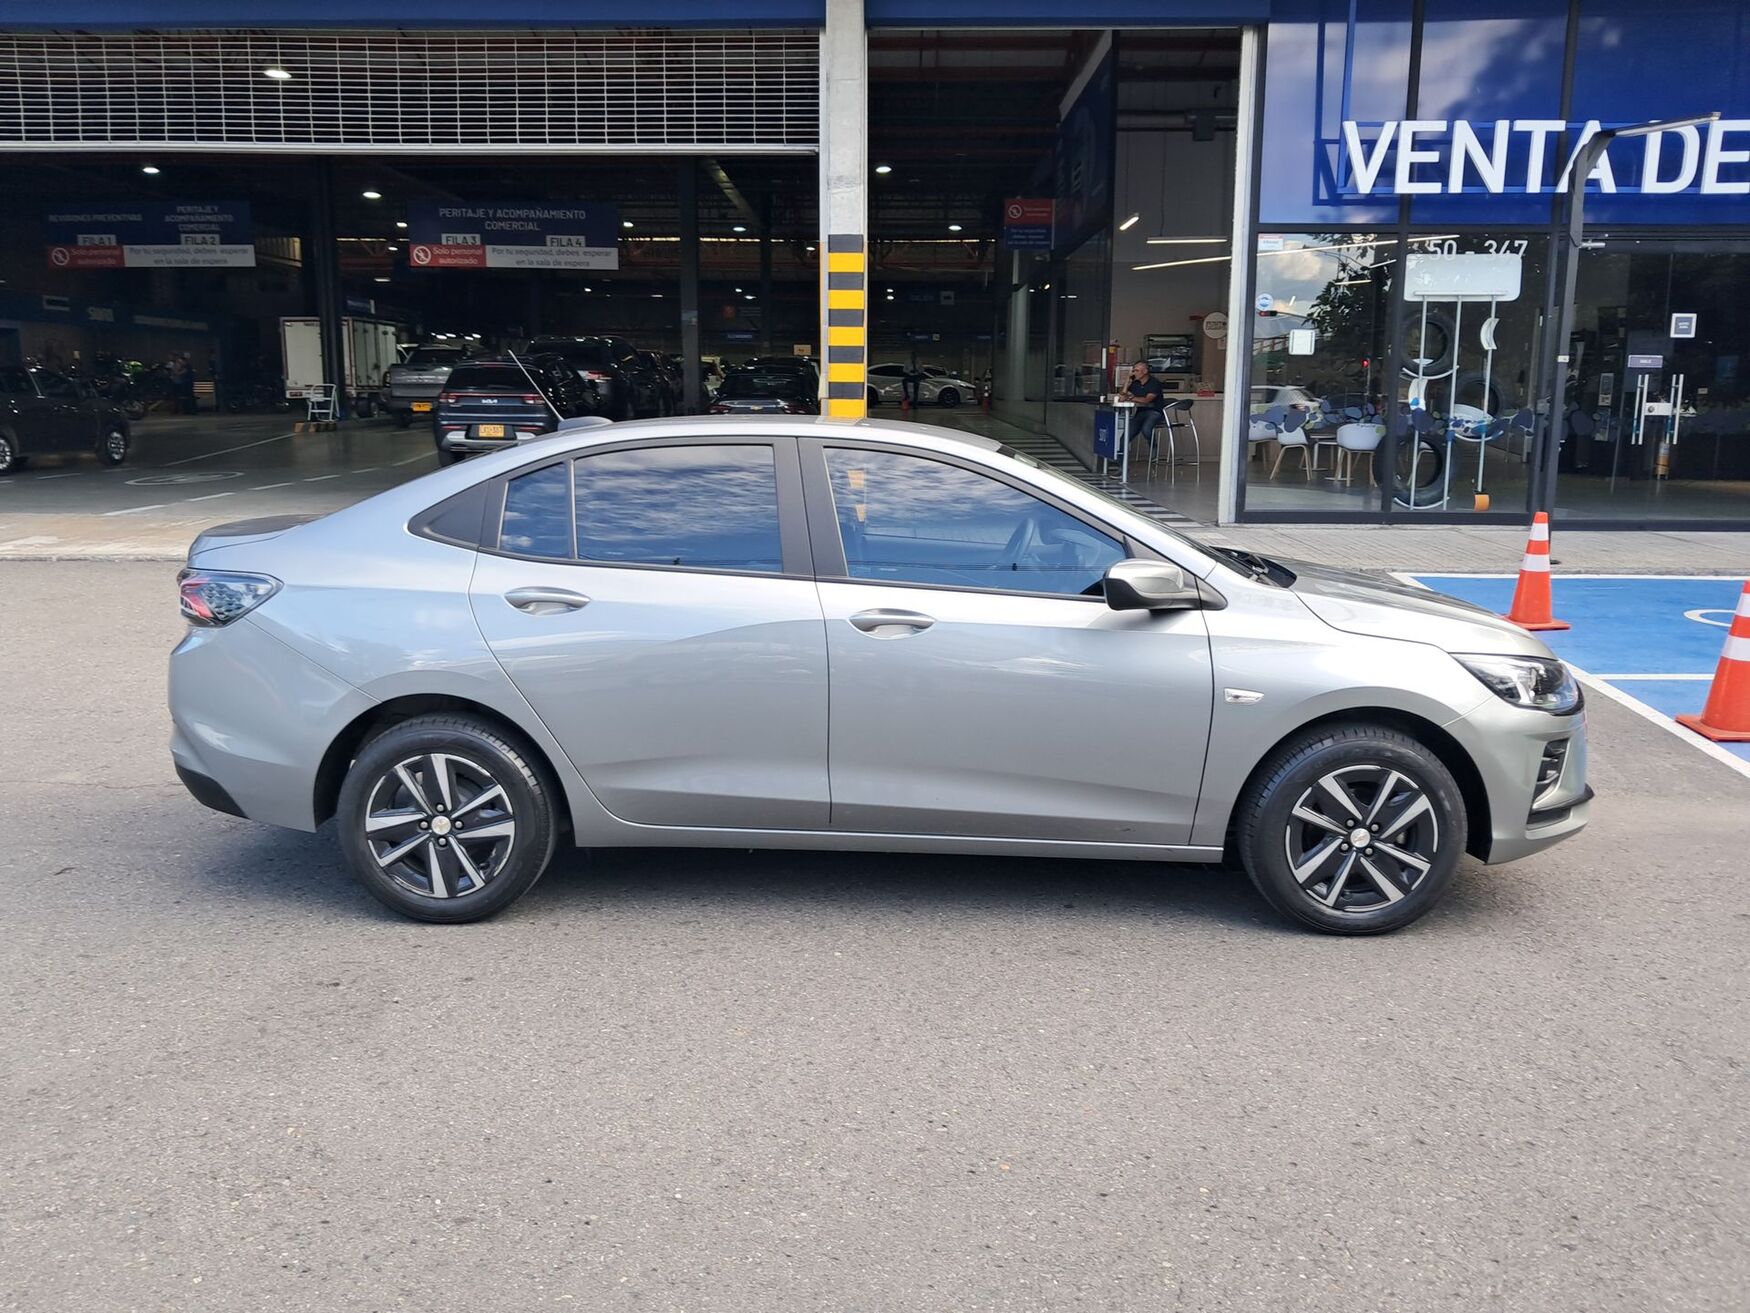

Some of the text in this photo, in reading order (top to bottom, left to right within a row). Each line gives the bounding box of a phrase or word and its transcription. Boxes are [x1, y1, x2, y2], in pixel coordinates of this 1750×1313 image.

[1343, 120, 1750, 194] VENTA DE
[439, 207, 586, 219] PERITAJE Y ACOMPAÑAMIENTO
[484, 221, 540, 230] COMERCIAL
[184, 236, 216, 245] FILA 2
[445, 236, 477, 245] FILA 3
[550, 237, 582, 247] FILA 4
[432, 247, 483, 257] Solo personal
